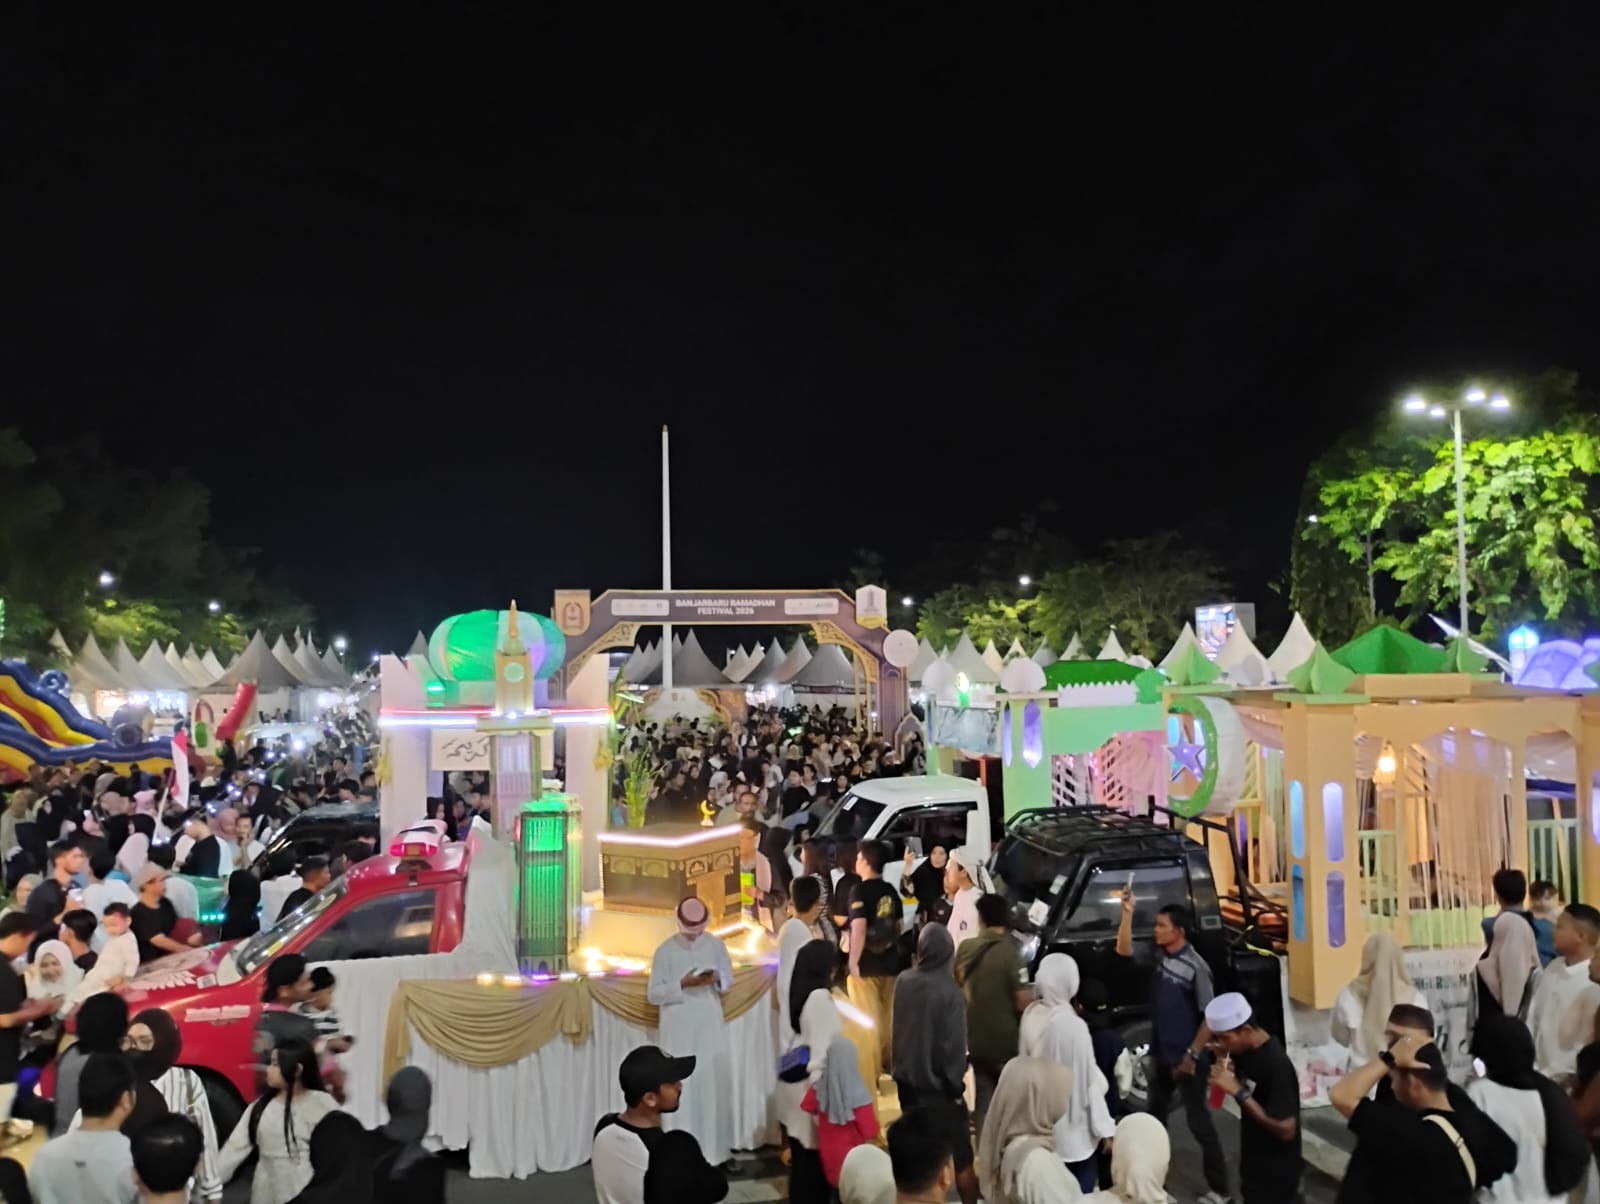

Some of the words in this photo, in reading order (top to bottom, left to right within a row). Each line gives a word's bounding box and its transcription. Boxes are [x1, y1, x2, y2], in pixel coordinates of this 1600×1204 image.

[675, 599, 729, 607] BANJARBARU
[730, 599, 776, 607] RAMADHAN
[697, 607, 734, 615] FESTIVAL
